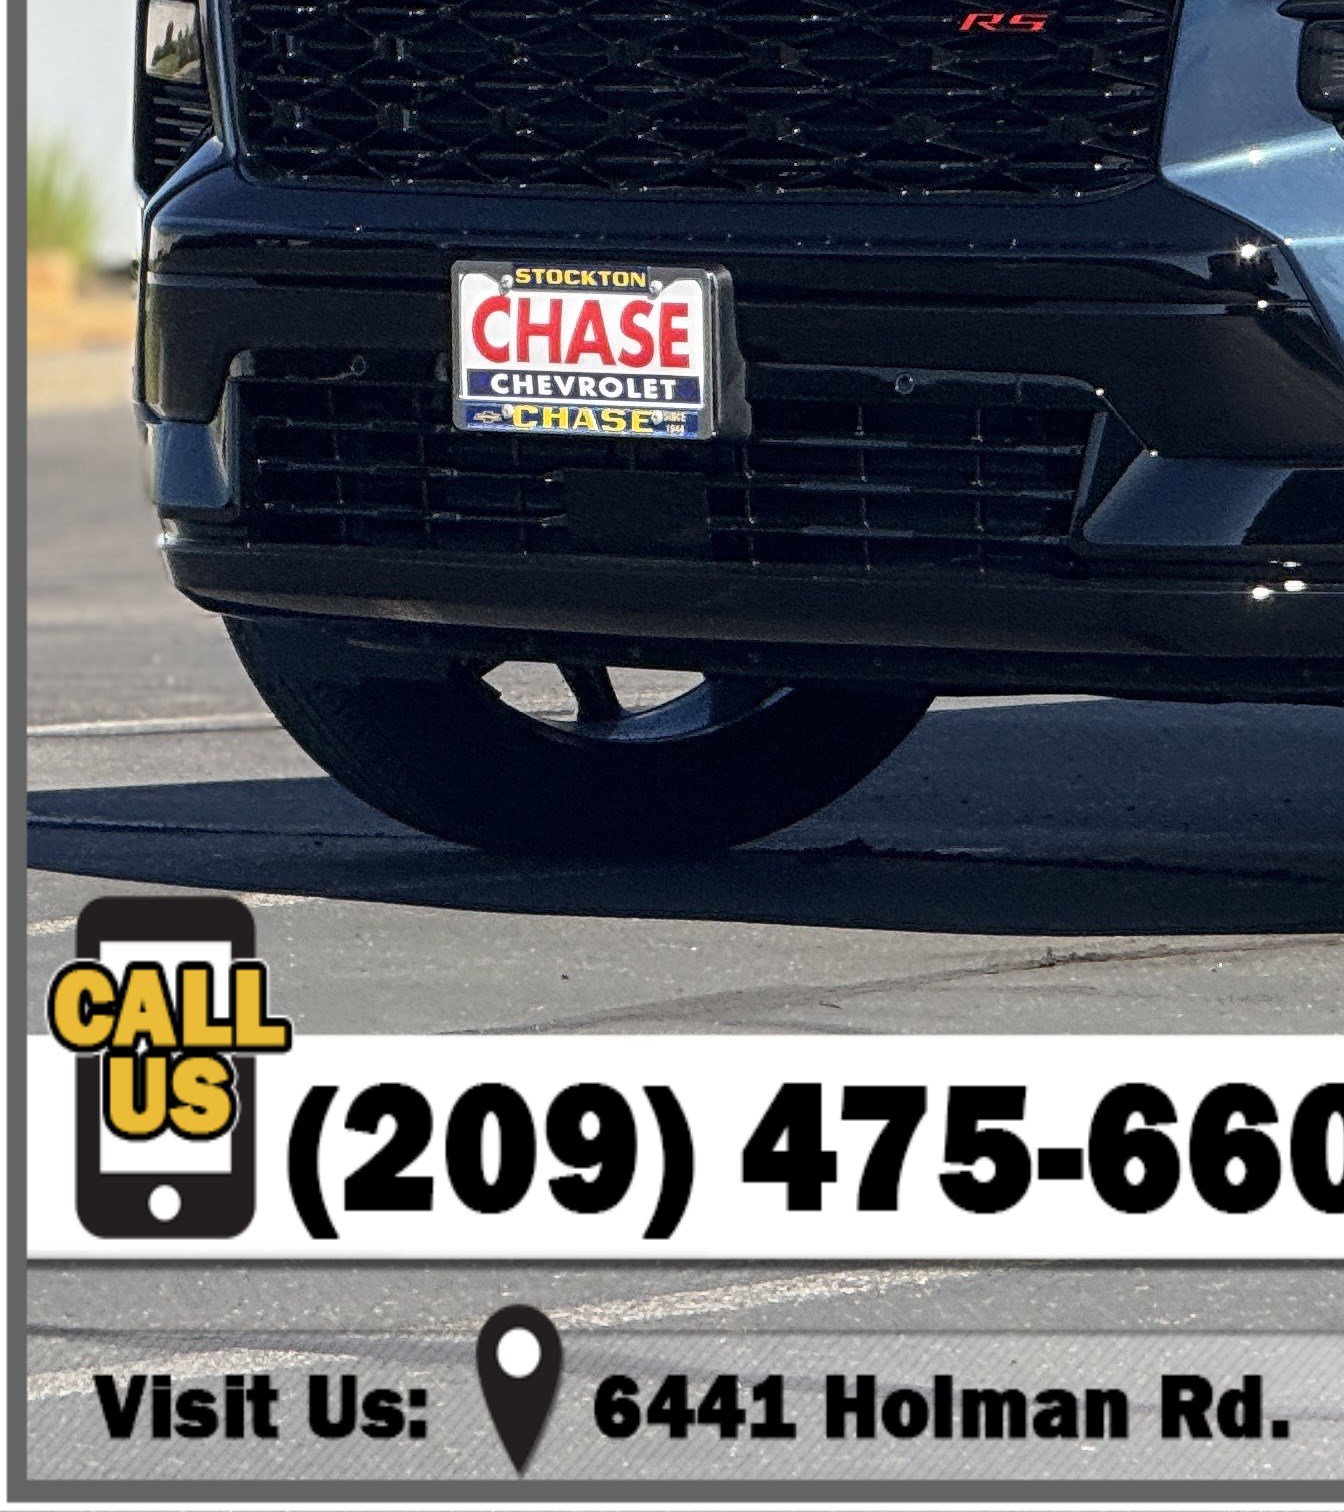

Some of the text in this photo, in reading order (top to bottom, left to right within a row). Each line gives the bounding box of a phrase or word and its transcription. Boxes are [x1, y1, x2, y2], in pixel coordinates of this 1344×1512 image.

[960, 13, 1048, 32] RS
[515, 267, 647, 289] STOCKTON
[471, 295, 690, 369] CHASE
[490, 373, 677, 400] CHEVROLET
[511, 404, 654, 433] CHASE
